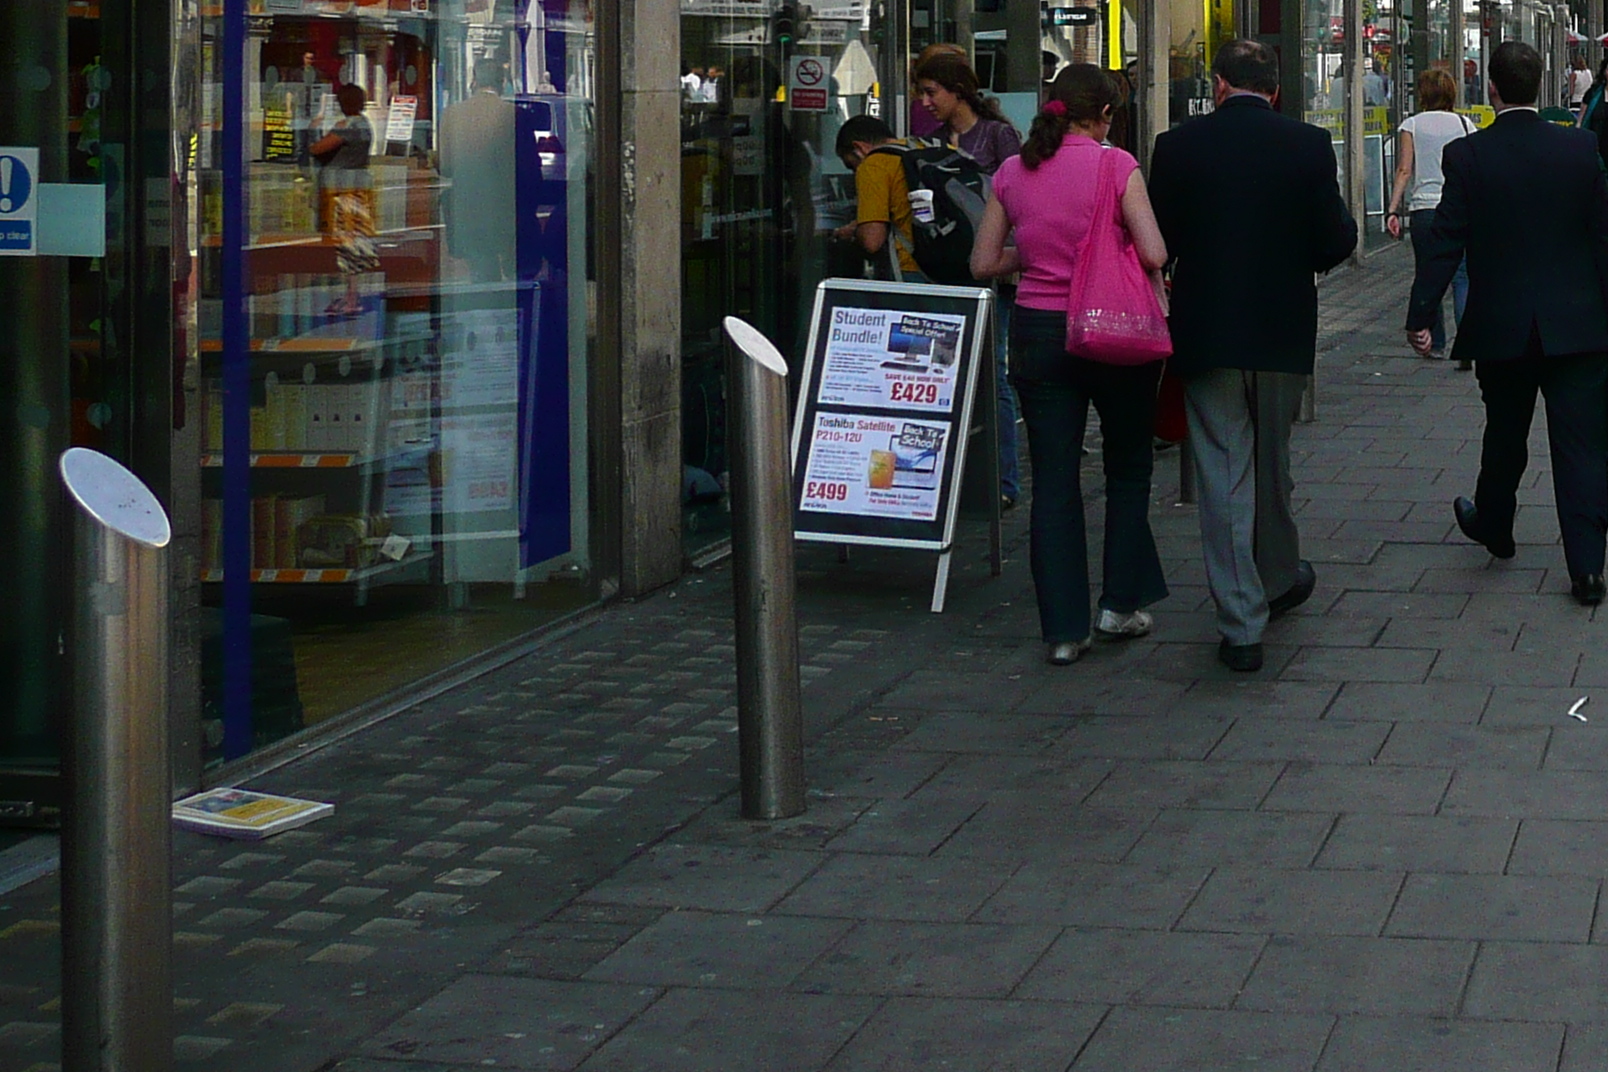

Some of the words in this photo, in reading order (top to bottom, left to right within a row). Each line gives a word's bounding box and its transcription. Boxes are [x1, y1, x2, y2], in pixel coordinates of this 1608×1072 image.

[7, 231, 30, 240] clear
[834, 310, 886, 327] Student
[832, 328, 883, 345] Bundle!
[890, 381, 938, 404] £429
[818, 416, 855, 429] Toshiba
[857, 419, 896, 432] Satellite
[904, 425, 924, 435] Back
[927, 428, 937, 437] To
[816, 429, 862, 443] P210-12U
[901, 435, 936, 448] School
[806, 481, 847, 501] £499
